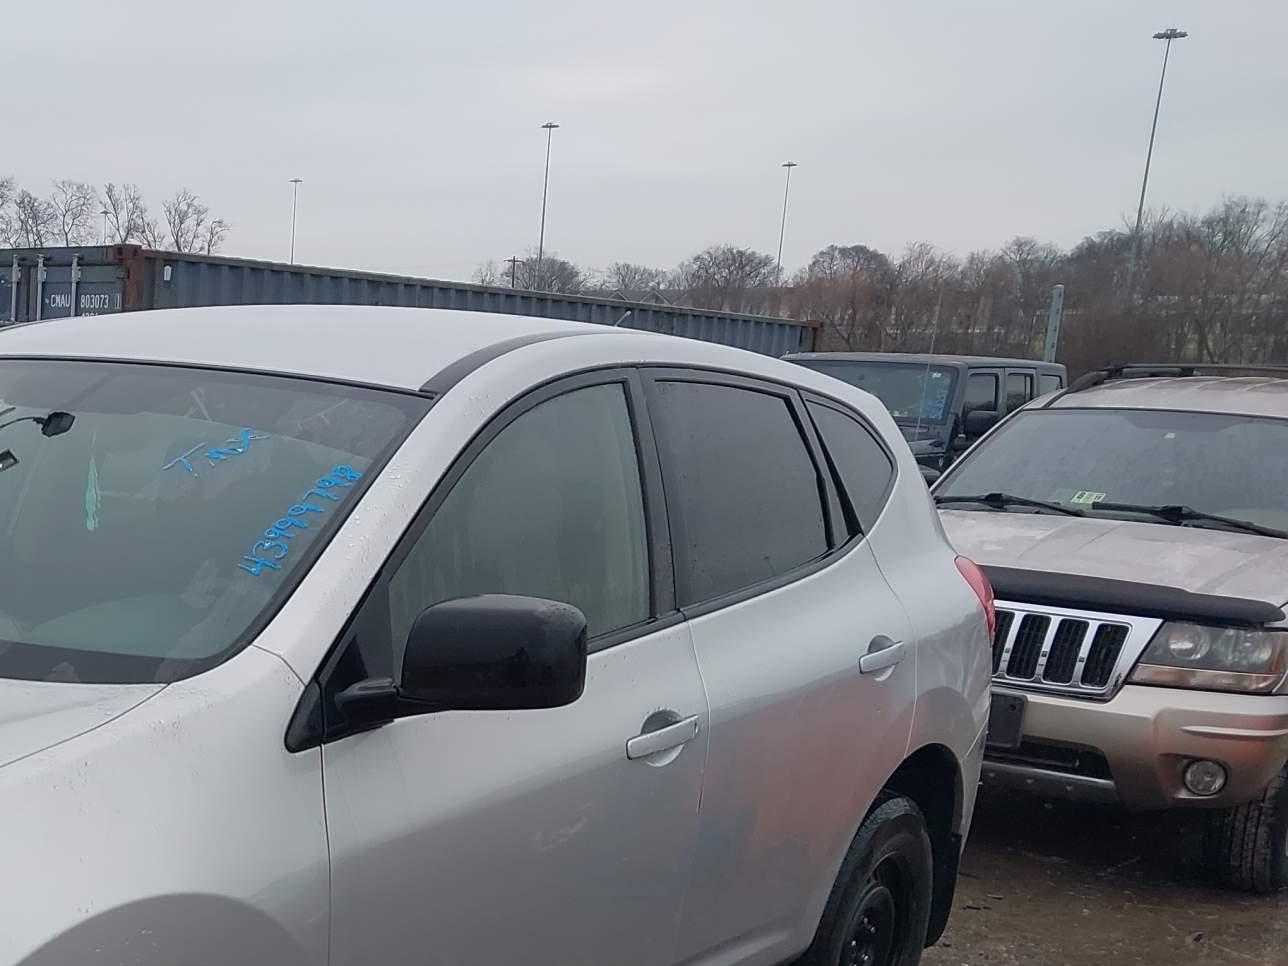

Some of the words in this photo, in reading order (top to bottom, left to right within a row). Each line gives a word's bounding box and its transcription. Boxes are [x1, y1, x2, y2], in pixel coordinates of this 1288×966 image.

[50, 294, 71, 308] CMAU
[80, 294, 109, 309] 803073
[237, 464, 361, 576] 43999798
